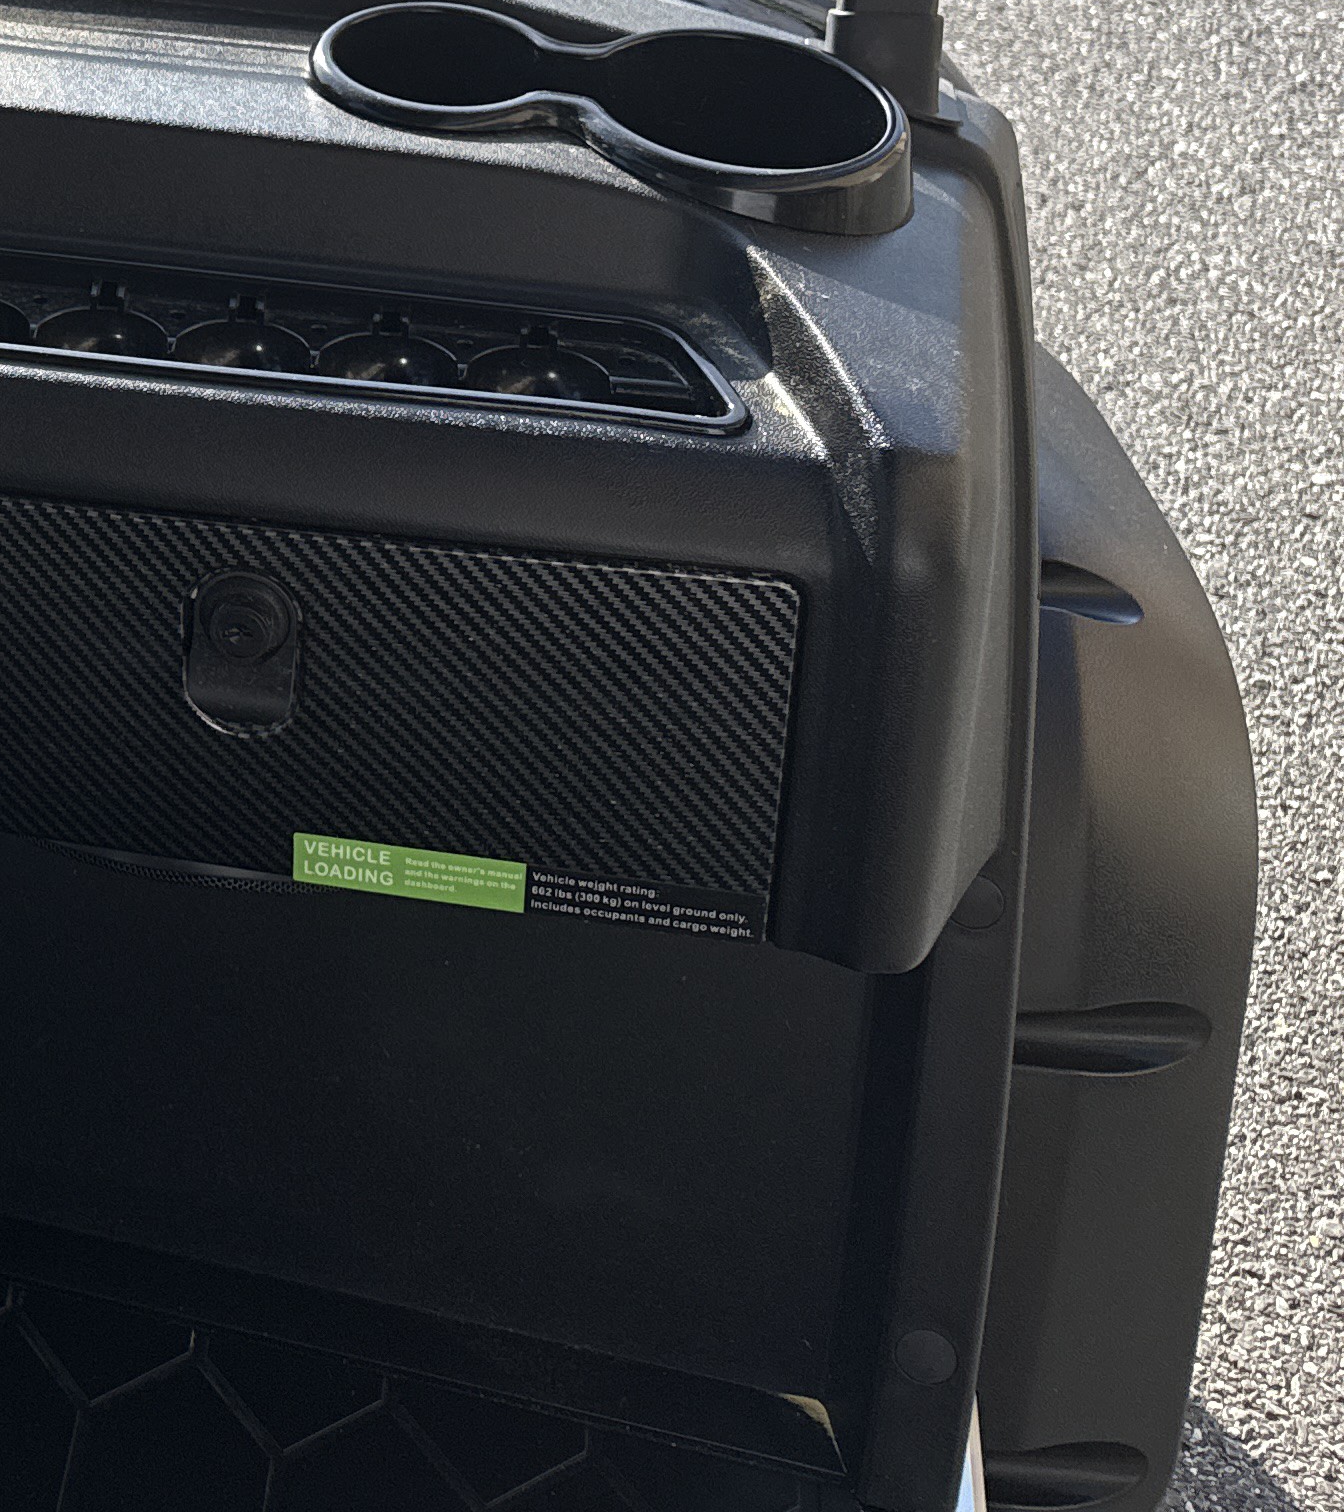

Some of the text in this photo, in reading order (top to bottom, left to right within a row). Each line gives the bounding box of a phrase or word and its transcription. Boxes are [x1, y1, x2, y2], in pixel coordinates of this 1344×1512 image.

[304, 839, 392, 866] VEHICLE
[304, 860, 394, 887] LOADING
[404, 868, 423, 879] and
[424, 870, 439, 880] the
[441, 873, 484, 887] warnings
[502, 880, 516, 891] the
[405, 857, 523, 881] Read the owner's manual
[404, 878, 458, 893] dashboard.
[532, 871, 576, 887] Vehicle
[577, 878, 618, 893] weight
[530, 898, 755, 938] Includes occupants and cargo weight.
[554, 888, 573, 900] lbs
[575, 891, 601, 903] (300
[602, 894, 622, 908] kg)
[623, 899, 640, 909] on
[642, 899, 671, 913] level
[672, 905, 717, 919] ground
[718, 911, 749, 925] only.
